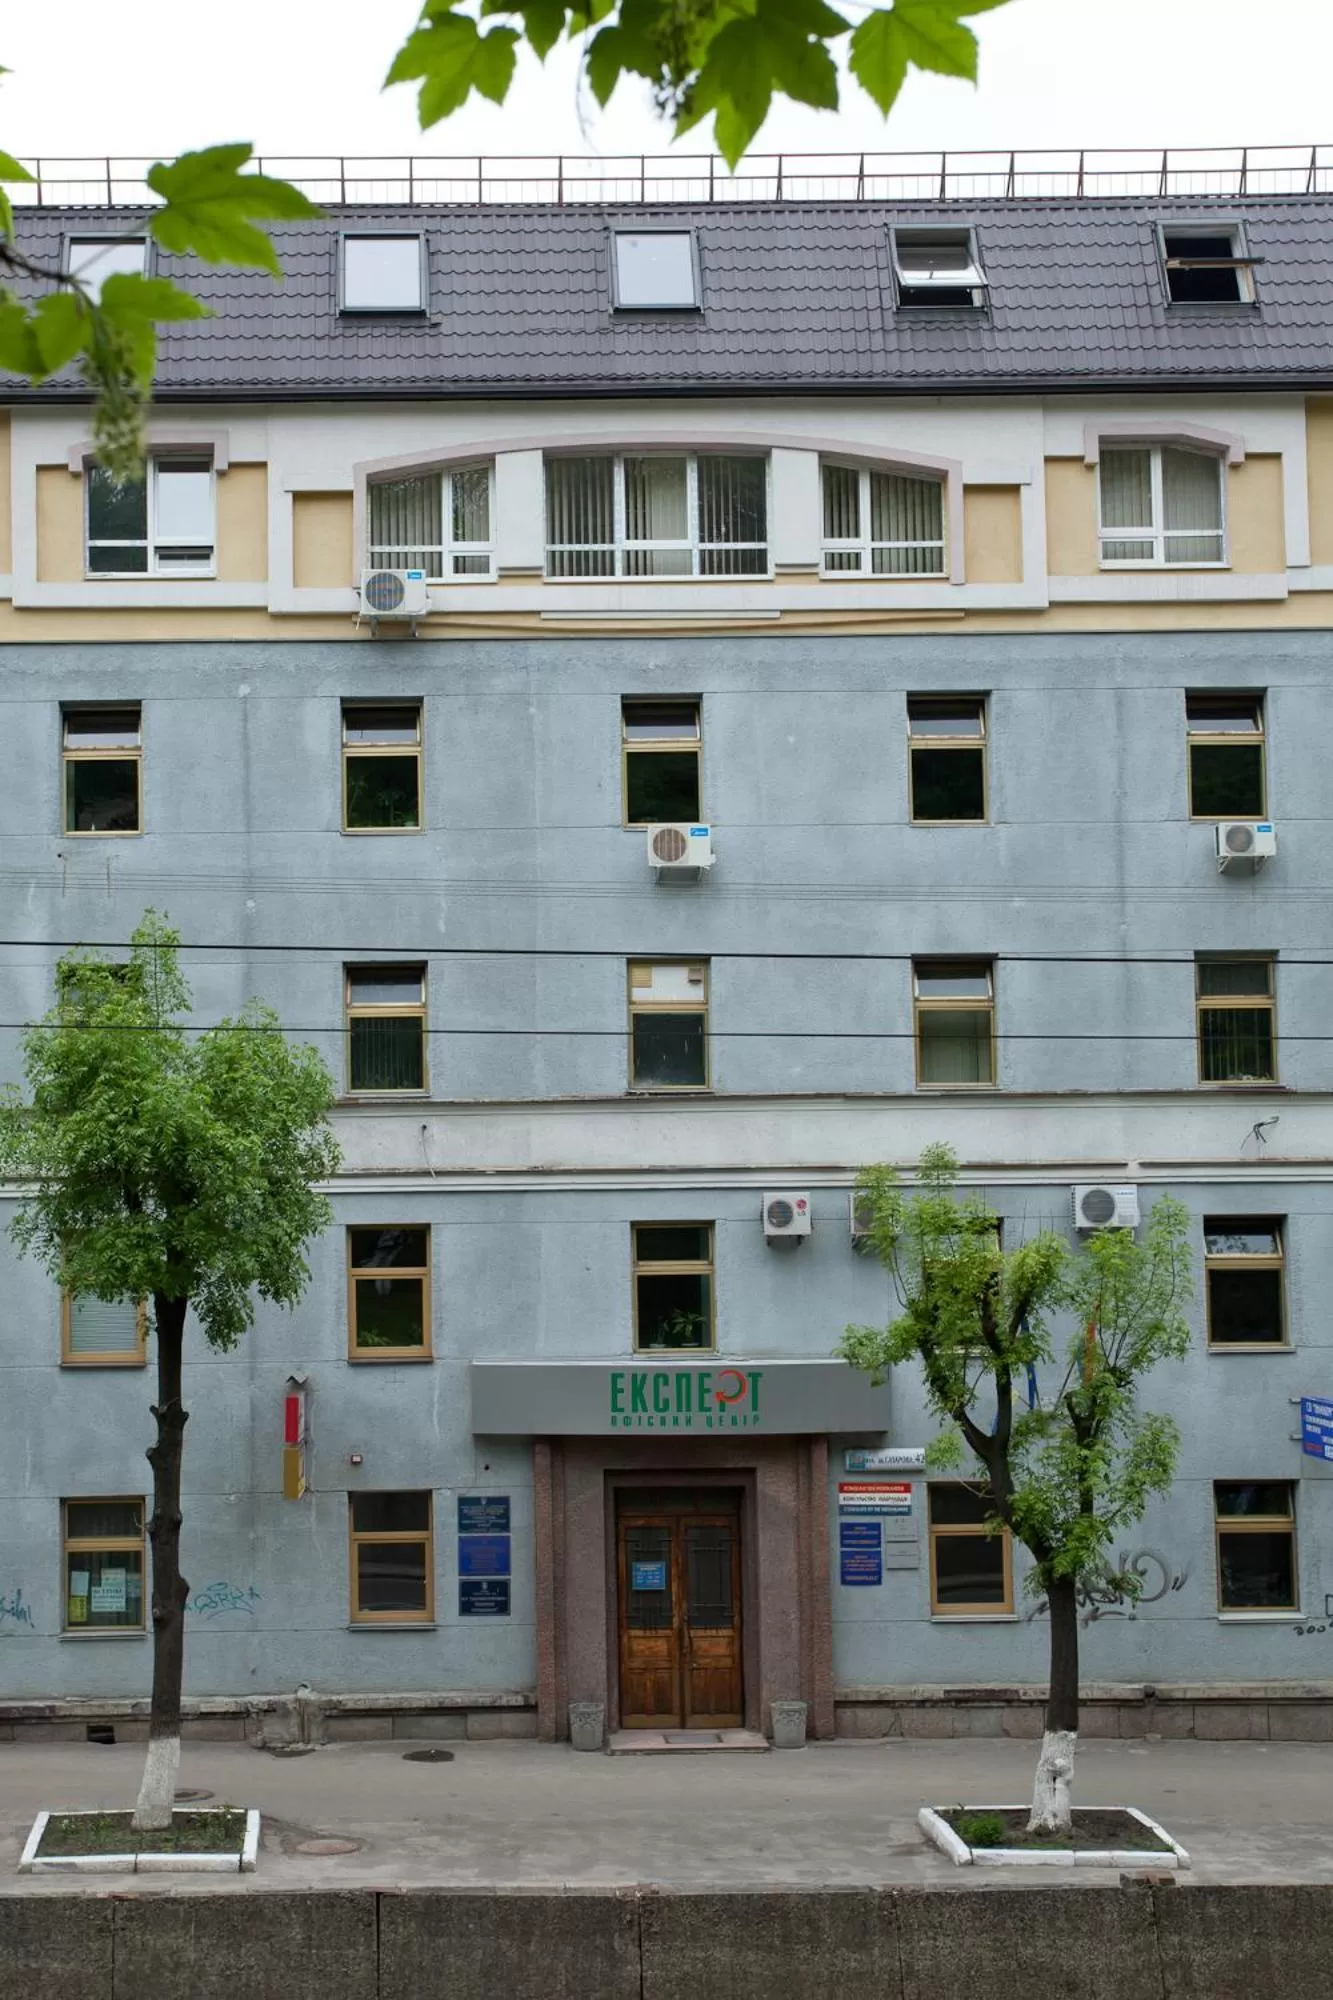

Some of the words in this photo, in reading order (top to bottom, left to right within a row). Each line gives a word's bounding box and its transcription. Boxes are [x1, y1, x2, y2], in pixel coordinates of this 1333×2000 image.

[610, 1369, 763, 1413] ЕКСПЕРТ
[611, 1413, 692, 1427] ОФІСНИЙ
[706, 1415, 760, 1428] ЦЕНТР
